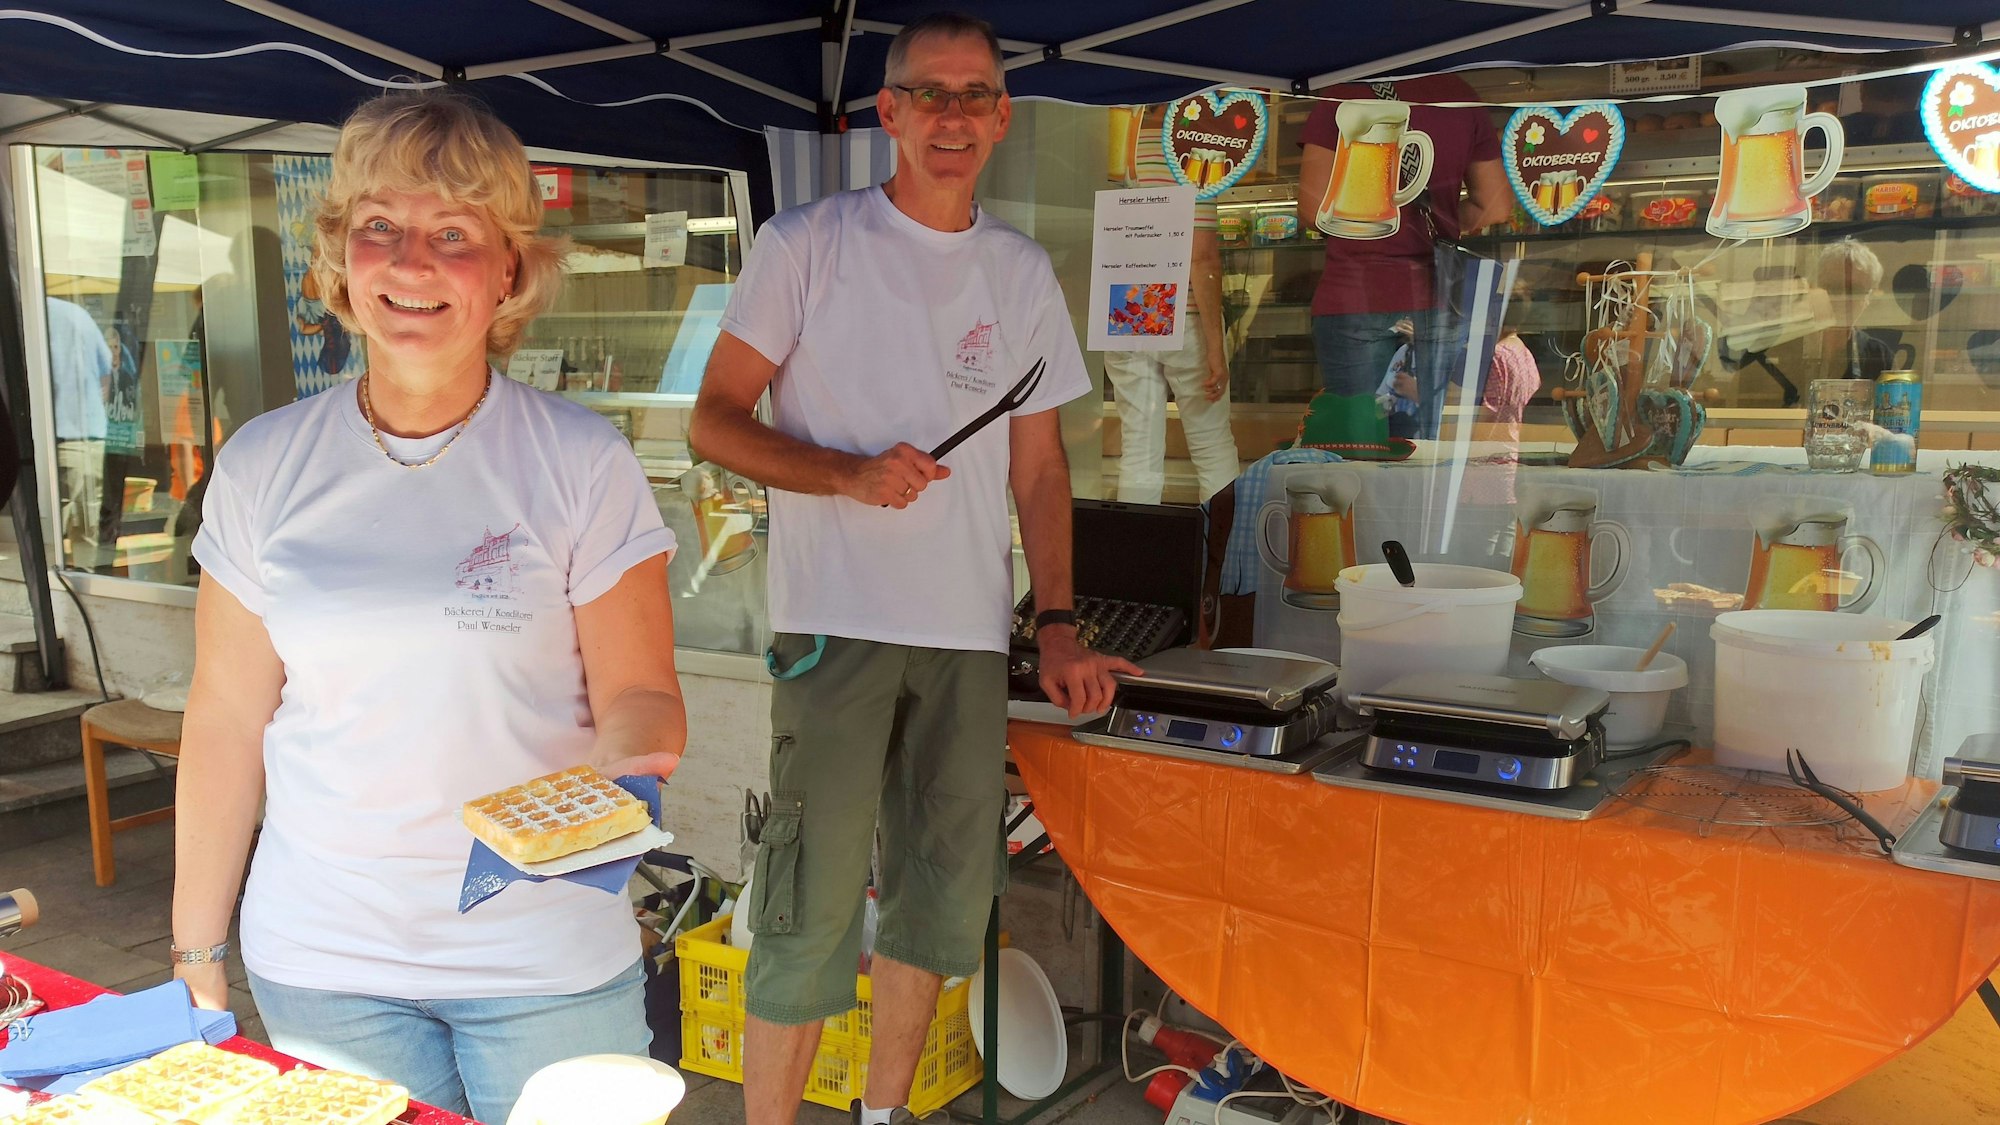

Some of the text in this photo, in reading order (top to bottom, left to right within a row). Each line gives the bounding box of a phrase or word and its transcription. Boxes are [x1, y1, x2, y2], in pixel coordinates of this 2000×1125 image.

[1176, 130, 1248, 149] OKTOBERFEST
[1522, 152, 1601, 168] OKTOBERFEST
[1875, 185, 1902, 193] HARIBO
[444, 606, 533, 620] Bäckerei / Konditorei
[457, 621, 521, 633] Paul Wenseler
